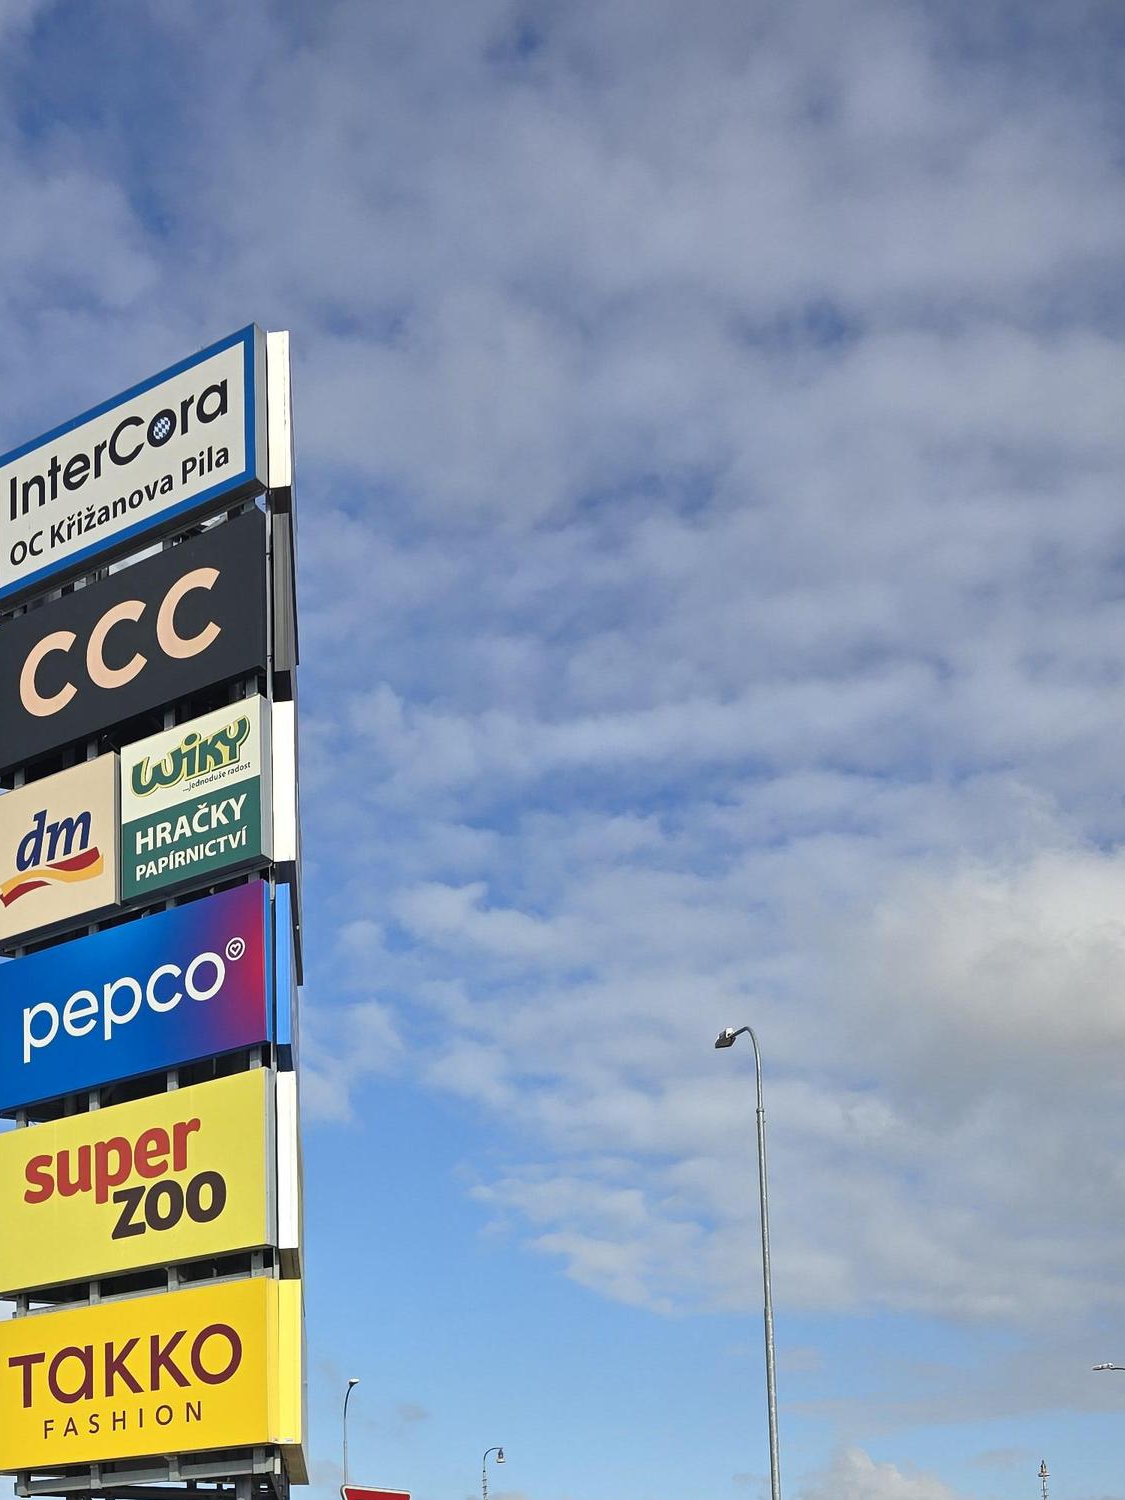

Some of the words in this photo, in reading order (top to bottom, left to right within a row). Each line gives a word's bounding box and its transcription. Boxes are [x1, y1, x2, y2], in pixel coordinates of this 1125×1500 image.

[10, 378, 228, 522] InterCora
[10, 530, 44, 566] OC
[49, 475, 174, 549] Křižanova
[181, 443, 229, 485] Pila
[19, 567, 221, 717] CCC
[227, 761, 251, 777] radost
[16, 809, 92, 872] dm
[136, 793, 247, 855] HRAČKY
[136, 825, 248, 881] PAPÍRNICTVÍ
[23, 951, 226, 1064] pepco
[24, 1118, 201, 1205] super
[111, 1170, 227, 1240] zoo
[44, 1400, 202, 1439] FASHION
